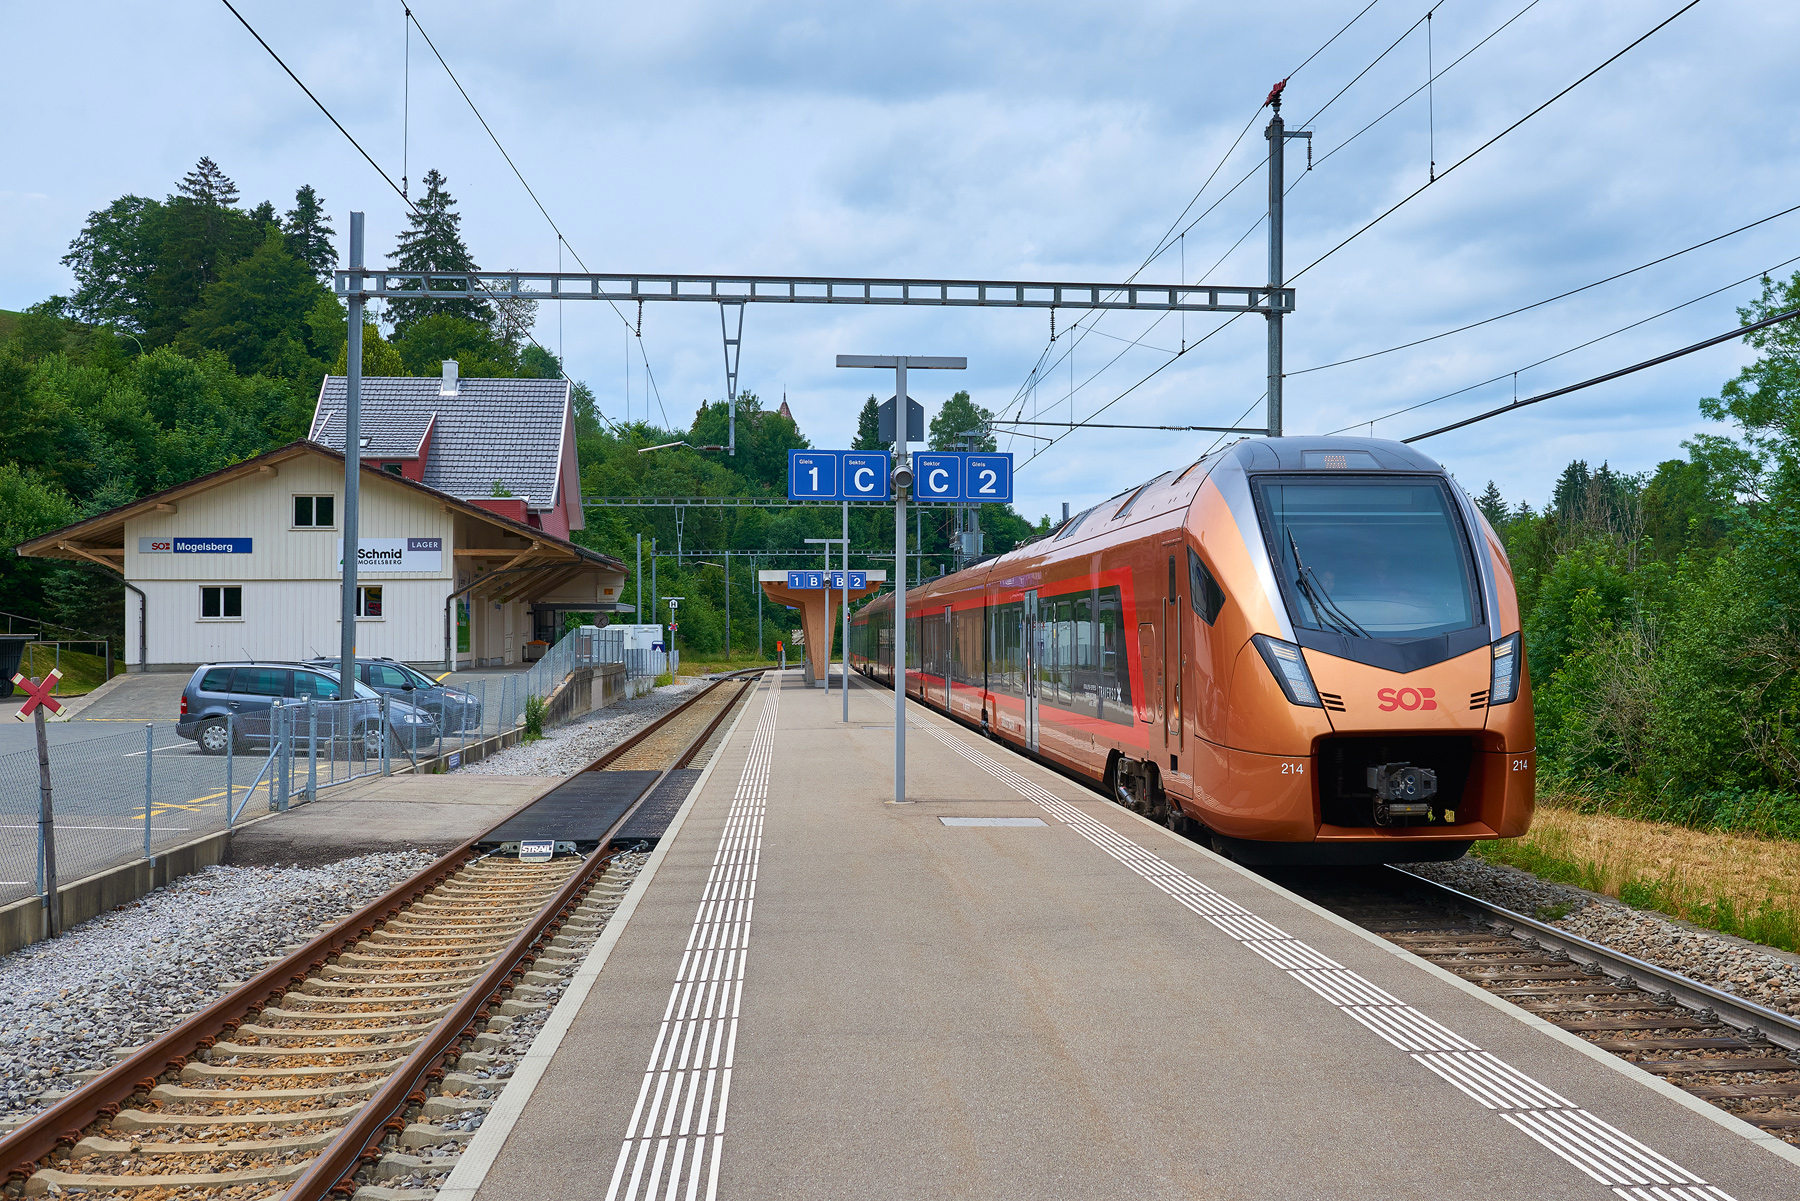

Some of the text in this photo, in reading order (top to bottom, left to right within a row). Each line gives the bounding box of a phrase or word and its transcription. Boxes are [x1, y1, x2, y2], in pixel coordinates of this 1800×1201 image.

[808, 467, 818, 491] 1
[854, 468, 874, 492] C
[928, 469, 949, 493] C
[978, 469, 997, 494] 2
[176, 542, 233, 552] Mogelsberg
[357, 548, 402, 559] Schmid
[794, 577, 799, 586] 1
[810, 577, 818, 586] B
[836, 577, 844, 587] B
[853, 577, 861, 587] 2
[1377, 687, 1437, 712] SOB
[1281, 763, 1304, 775] 214
[1512, 760, 1528, 771] 214
